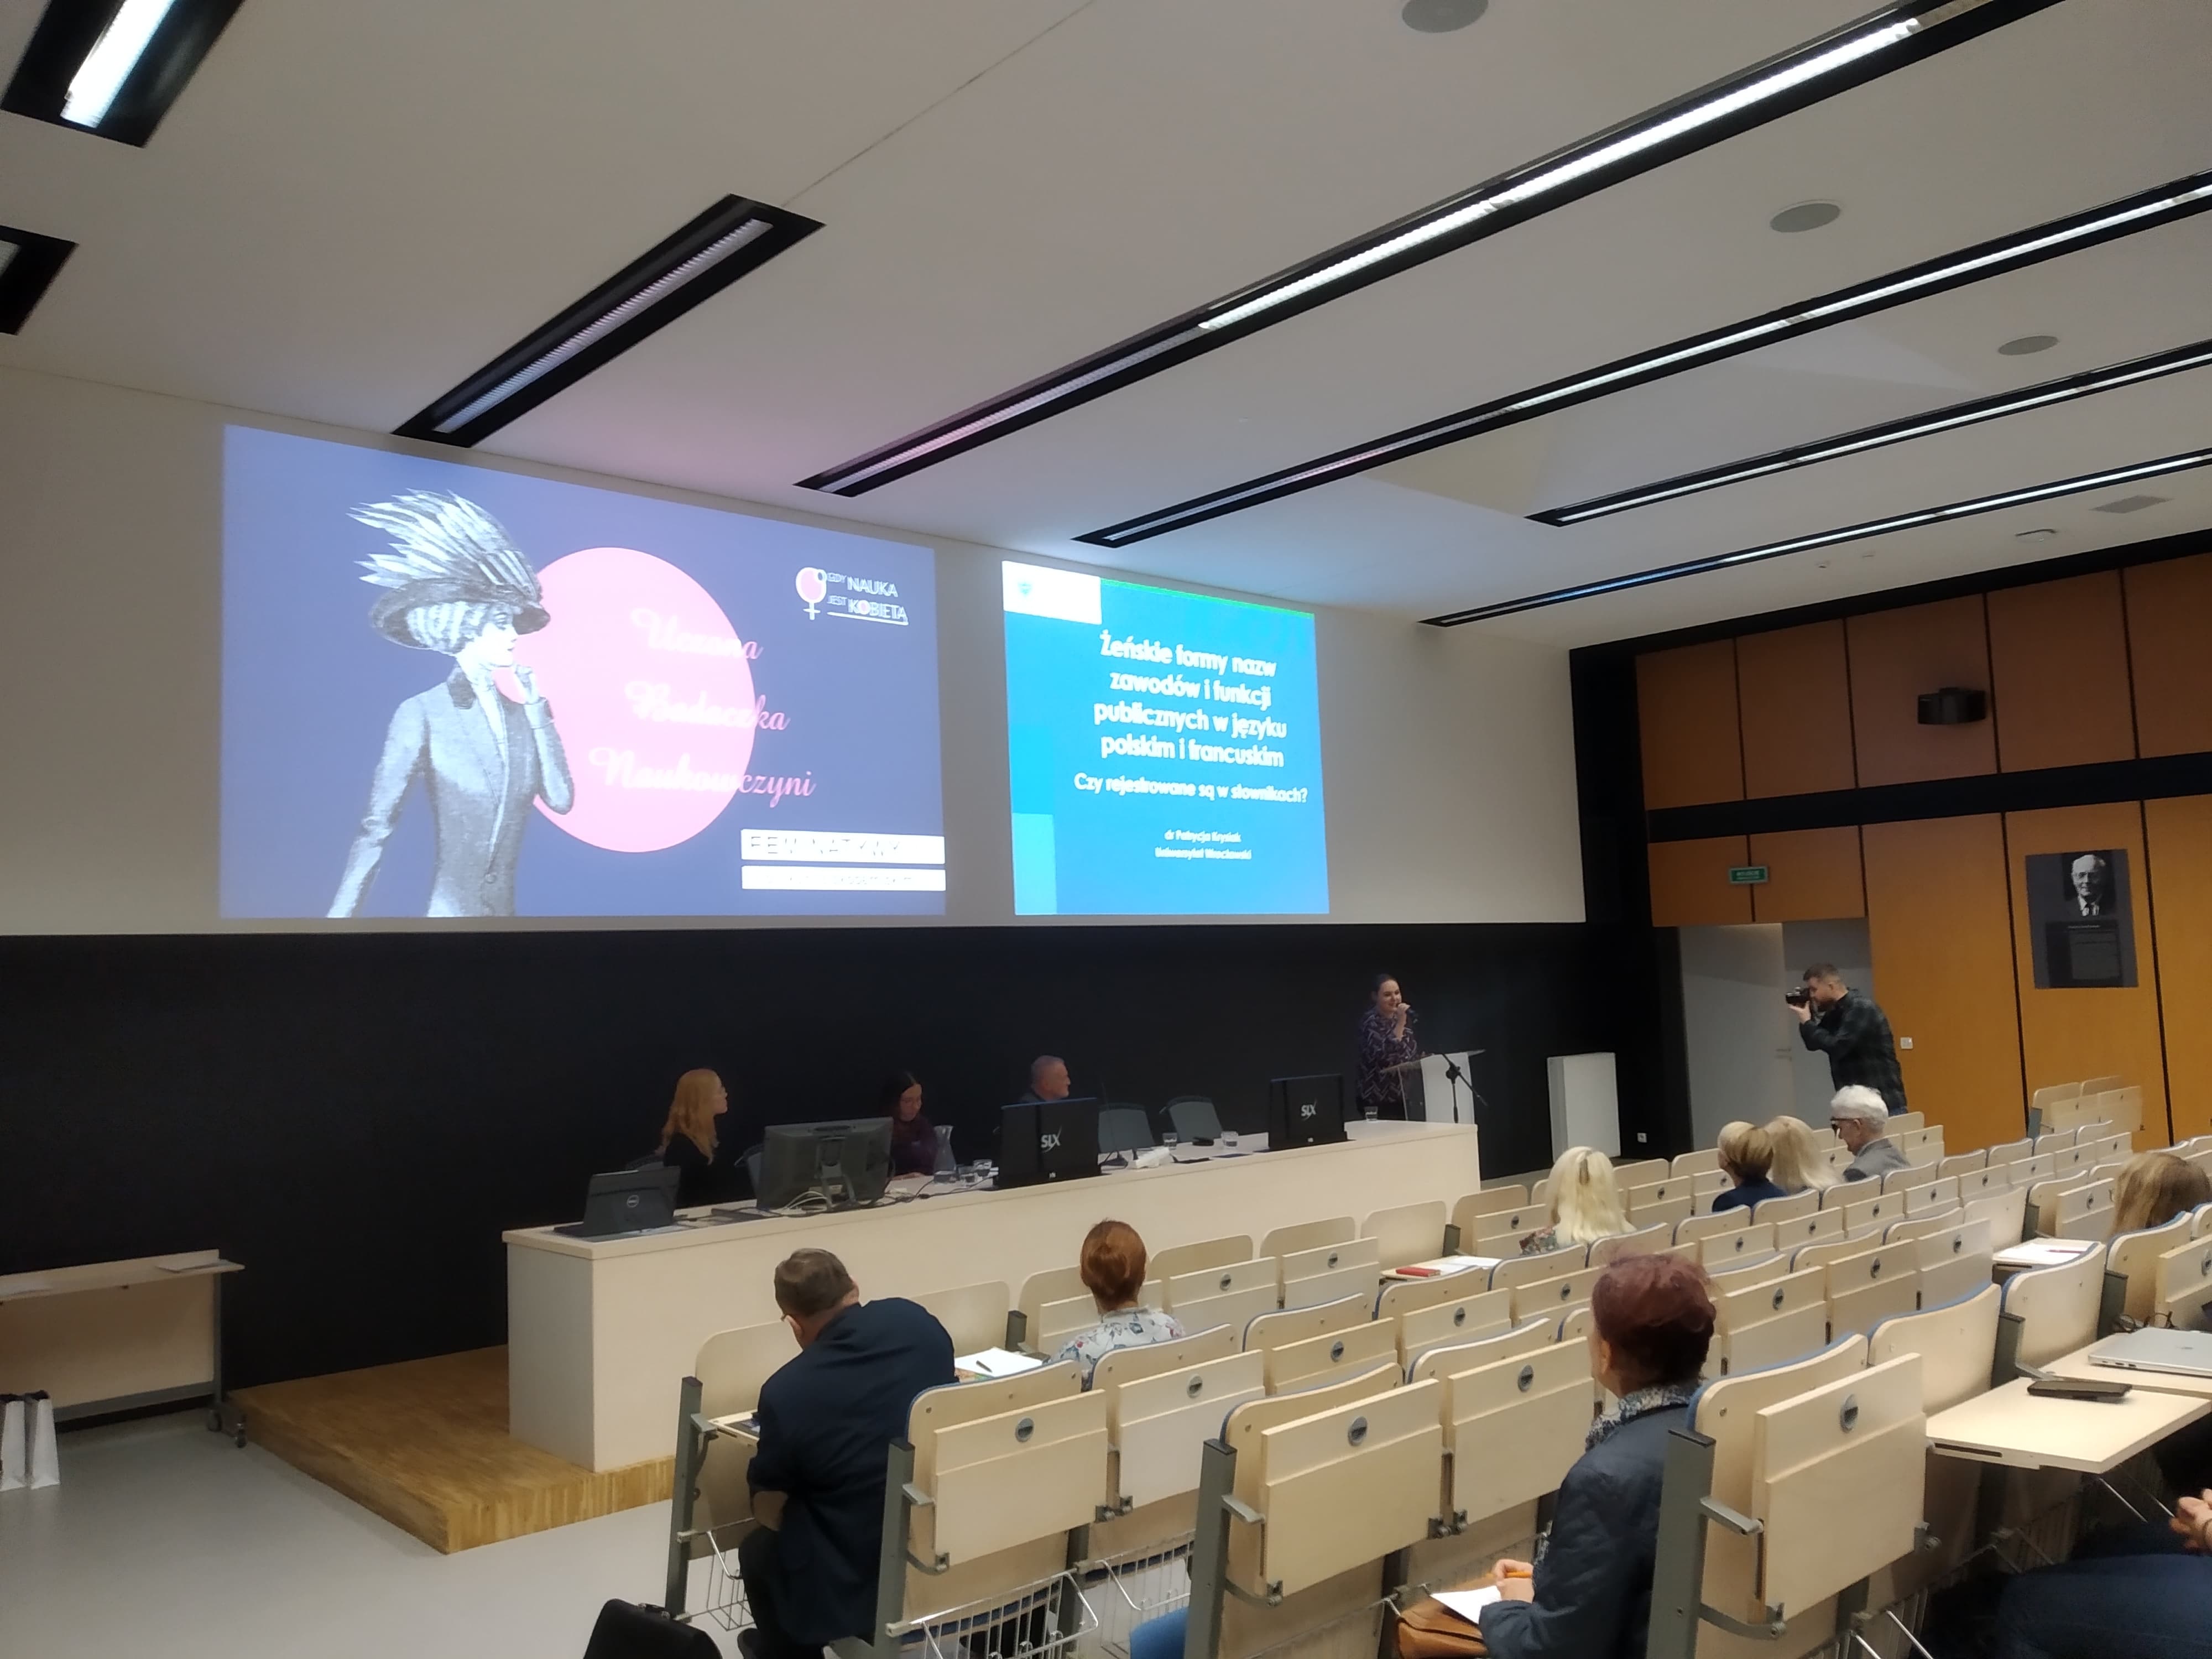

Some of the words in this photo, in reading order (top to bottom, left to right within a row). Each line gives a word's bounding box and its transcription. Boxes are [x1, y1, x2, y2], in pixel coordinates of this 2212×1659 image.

[847, 576, 899, 598] NAUKA
[827, 595, 847, 606] JEST
[848, 598, 909, 623] KOBIETA
[1099, 629, 1173, 664] Żeńskie
[1176, 644, 1228, 675] formy
[1232, 656, 1276, 677] nazw
[1110, 672, 1201, 698] zawodów
[1204, 679, 1211, 700] i
[1213, 680, 1271, 711] funkcji
[1094, 700, 1209, 733] publicznych
[1213, 715, 1229, 732] w
[1231, 712, 1287, 740] języku
[1101, 733, 1176, 759] polskim
[1179, 738, 1185, 759] i
[1188, 739, 1284, 767] francuskim
[1074, 773, 1103, 794] Czy
[1105, 775, 1196, 796] rejestrowane
[1198, 784, 1215, 801] są
[1217, 785, 1229, 797] w
